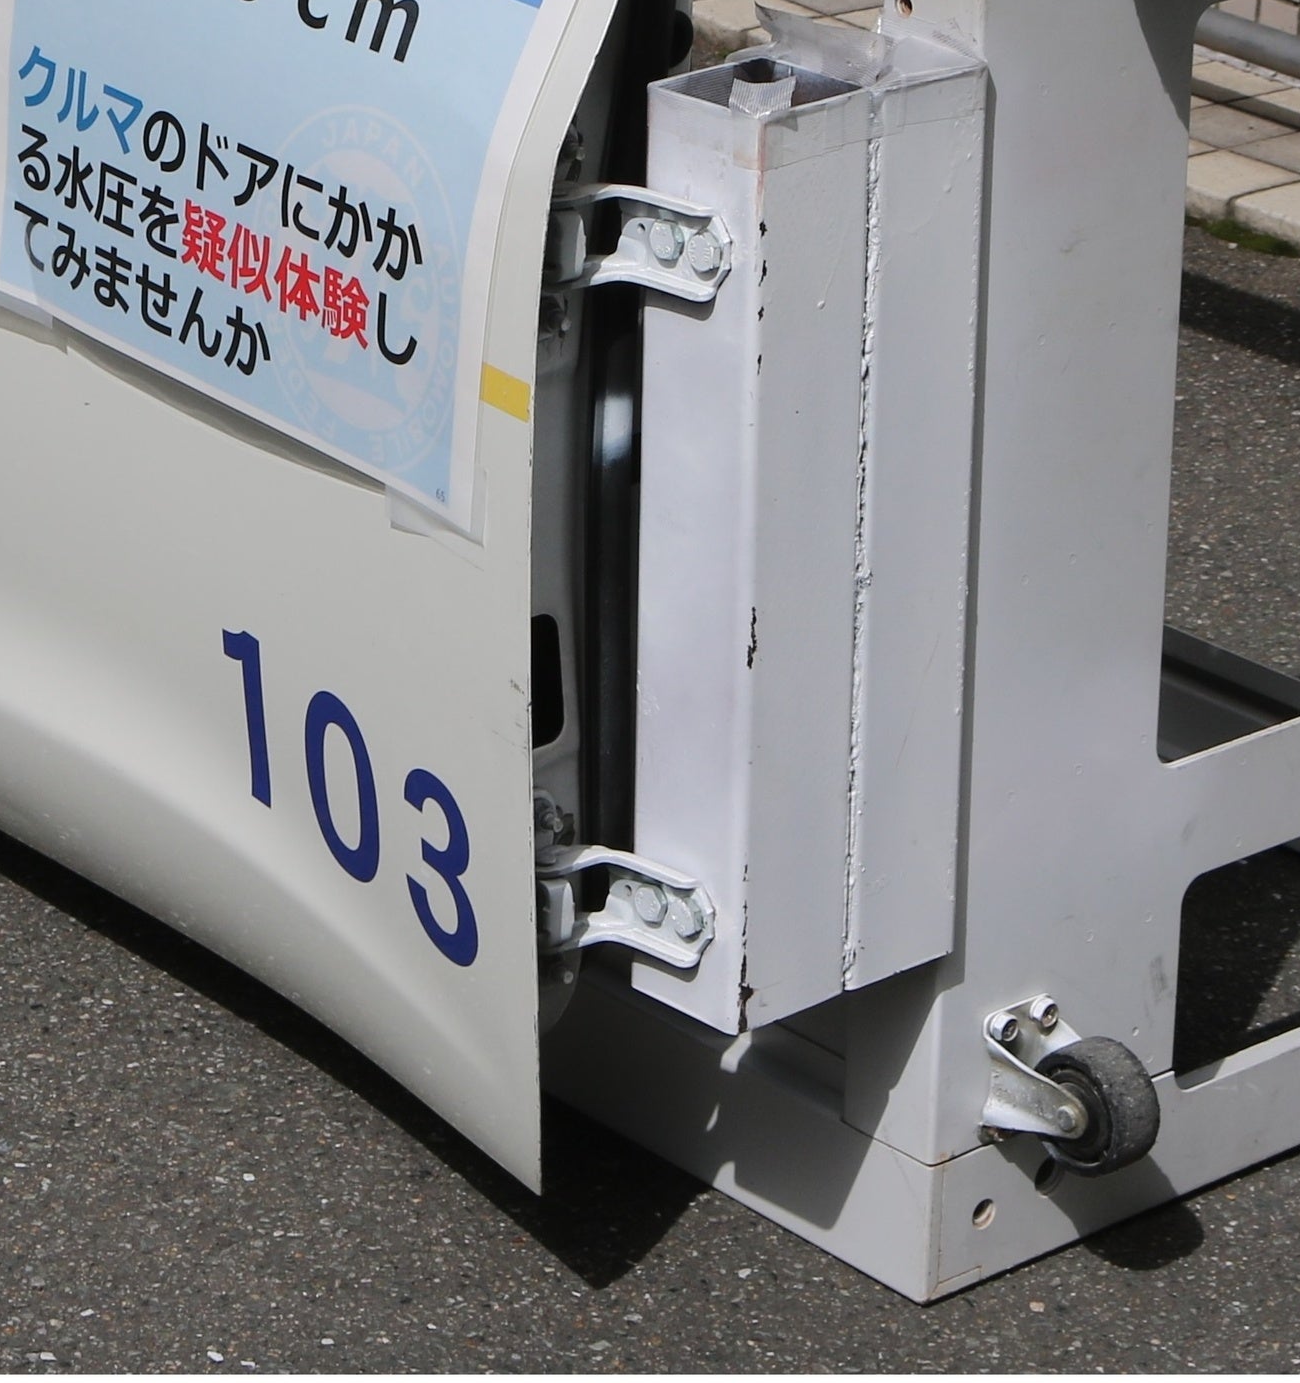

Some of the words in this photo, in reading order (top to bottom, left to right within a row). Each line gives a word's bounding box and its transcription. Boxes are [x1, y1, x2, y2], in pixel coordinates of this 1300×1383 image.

[17, 124, 418, 367] る水圧を疑似体験し
[18, 46, 423, 280] クルマのドアにかか
[13, 201, 271, 376] てみませんか
[222, 628, 479, 967] 103
